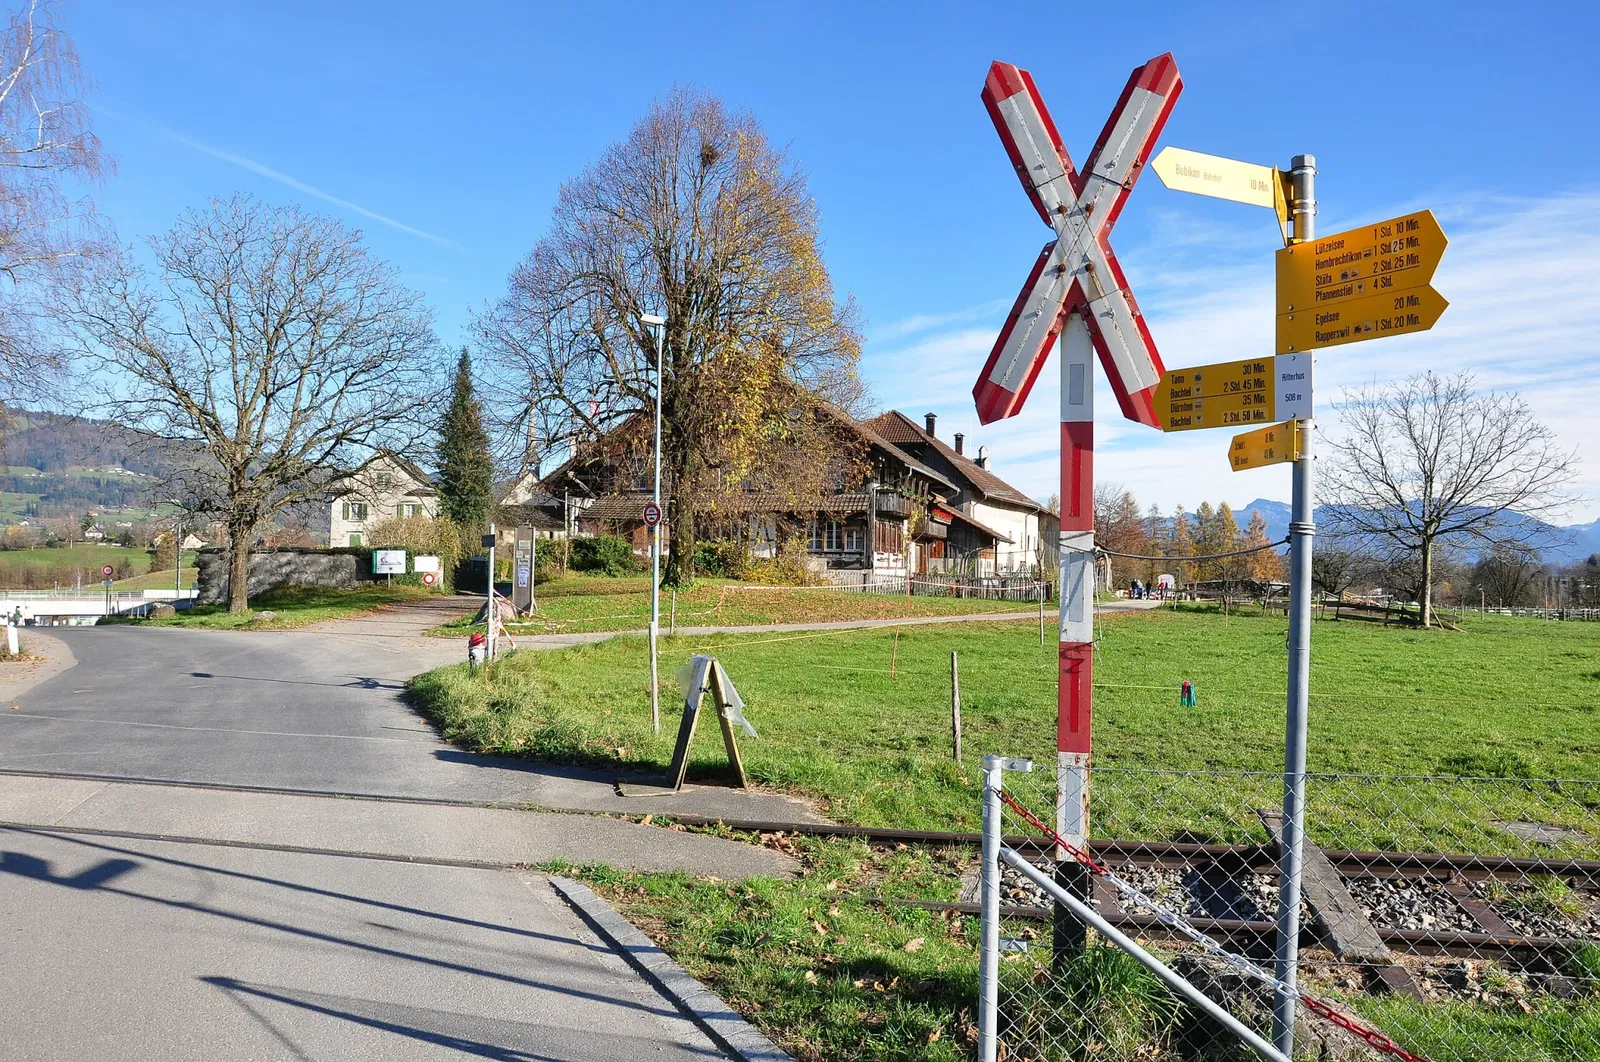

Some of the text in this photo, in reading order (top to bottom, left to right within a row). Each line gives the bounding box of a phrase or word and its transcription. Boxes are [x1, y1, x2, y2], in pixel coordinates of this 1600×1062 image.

[1176, 164, 1200, 178] Bubikon
[1251, 179, 1256, 190] 10
[1316, 219, 1419, 255] Lützelsee 1 Std. 10 Min.
[1316, 251, 1361, 270] Hombrechtikon
[1374, 245, 1377, 256] 1
[1393, 240, 1403, 252] 25
[1406, 237, 1419, 248] Min.
[1316, 254, 1420, 286] Stäfa 2 Std. 25 Min.
[1316, 276, 1392, 301] Pfannenstiel 4 Std.
[1316, 296, 1420, 326] Egelsee 20 Min.
[1316, 314, 1420, 343] Rapperswil 1 Std. 20 Min.
[1171, 363, 1265, 384] Tann 30 Min.
[1282, 373, 1304, 381] Ritterhus
[1171, 378, 1266, 398] Bachtel 2 Std. 45 Min.
[1285, 393, 1295, 402] 508
[1171, 394, 1266, 413] Dürnten 35 Min.
[1171, 409, 1265, 426] Bachtel 2 Std. 50 Min.
